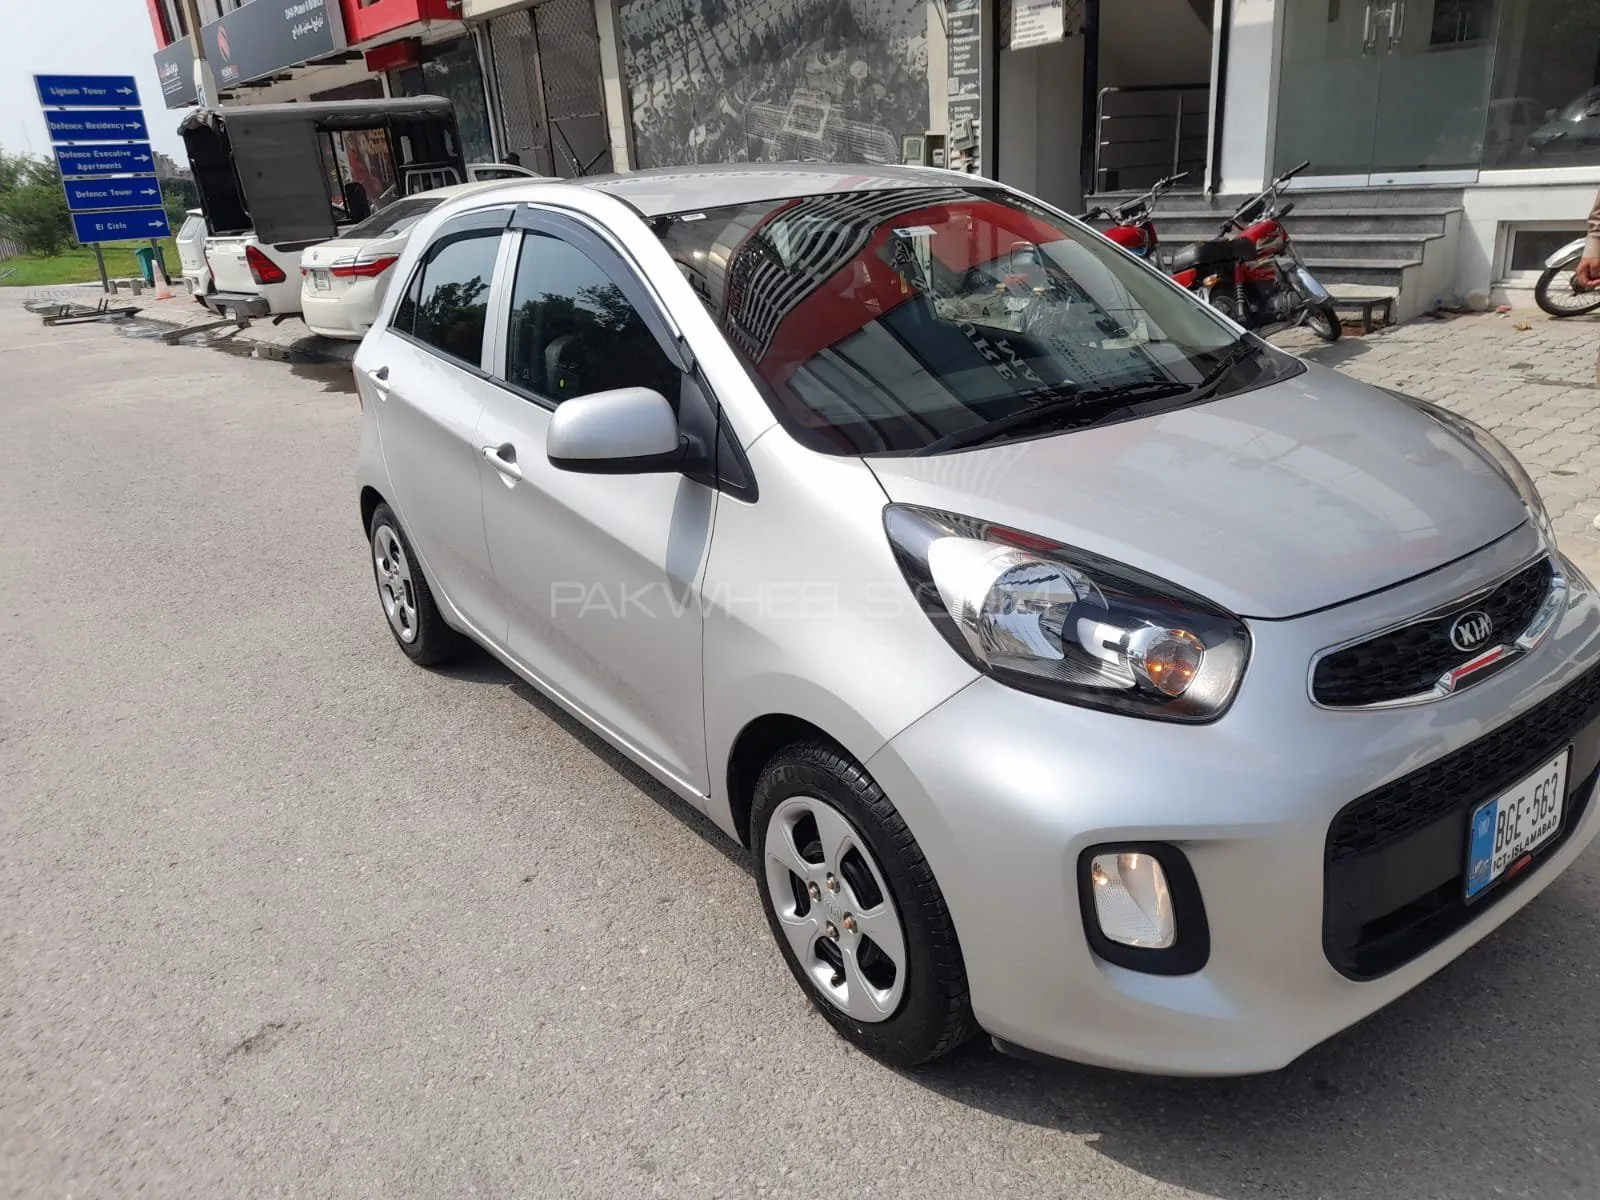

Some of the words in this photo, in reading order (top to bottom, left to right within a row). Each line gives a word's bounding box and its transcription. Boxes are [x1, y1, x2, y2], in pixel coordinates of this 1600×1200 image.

[50, 122, 83, 130] Defence
[84, 121, 125, 130] Residency
[59, 151, 91, 159] Defence
[92, 150, 131, 158] Executive
[77, 162, 122, 171] Apartments
[75, 190, 107, 198] Defence
[95, 223, 104, 231] El
[106, 222, 127, 230] Cielo
[1457, 616, 1491, 646] KIA
[1492, 815, 1558, 874] ICT-ISLAMABAD
